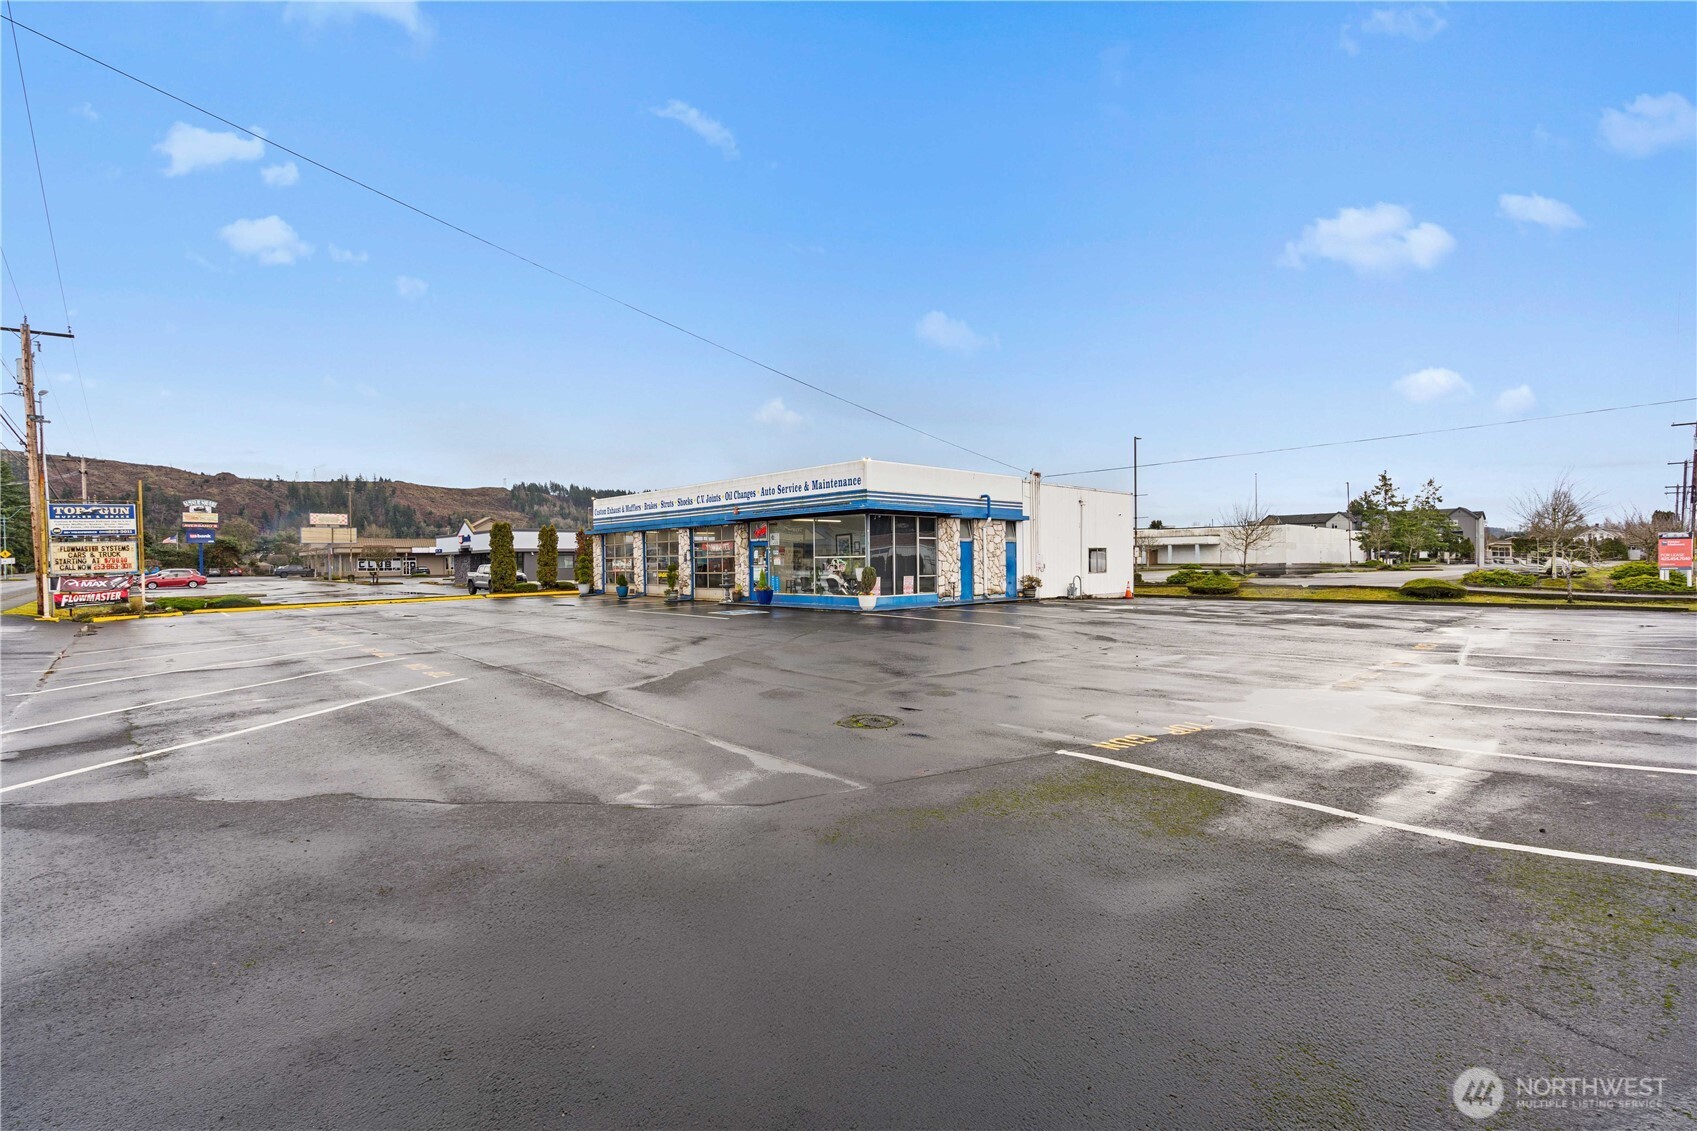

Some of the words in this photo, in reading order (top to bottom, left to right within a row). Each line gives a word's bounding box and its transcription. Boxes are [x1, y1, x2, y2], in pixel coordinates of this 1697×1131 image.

[625, 503, 641, 512] Mufflers
[644, 502, 657, 510] Brakes
[660, 500, 674, 509] Struts
[677, 497, 693, 506] Shocks
[706, 493, 721, 503] Joints
[724, 491, 732, 500] Oil
[733, 489, 756, 501] Changes
[760, 486, 776, 497] Auto
[777, 482, 802, 495] Service
[803, 481, 809, 492] &
[811, 476, 862, 490] Maintenance
[53, 506, 84, 515] TOP
[99, 506, 130, 515] GUN
[60, 591, 122, 607] FLOWMASTER
